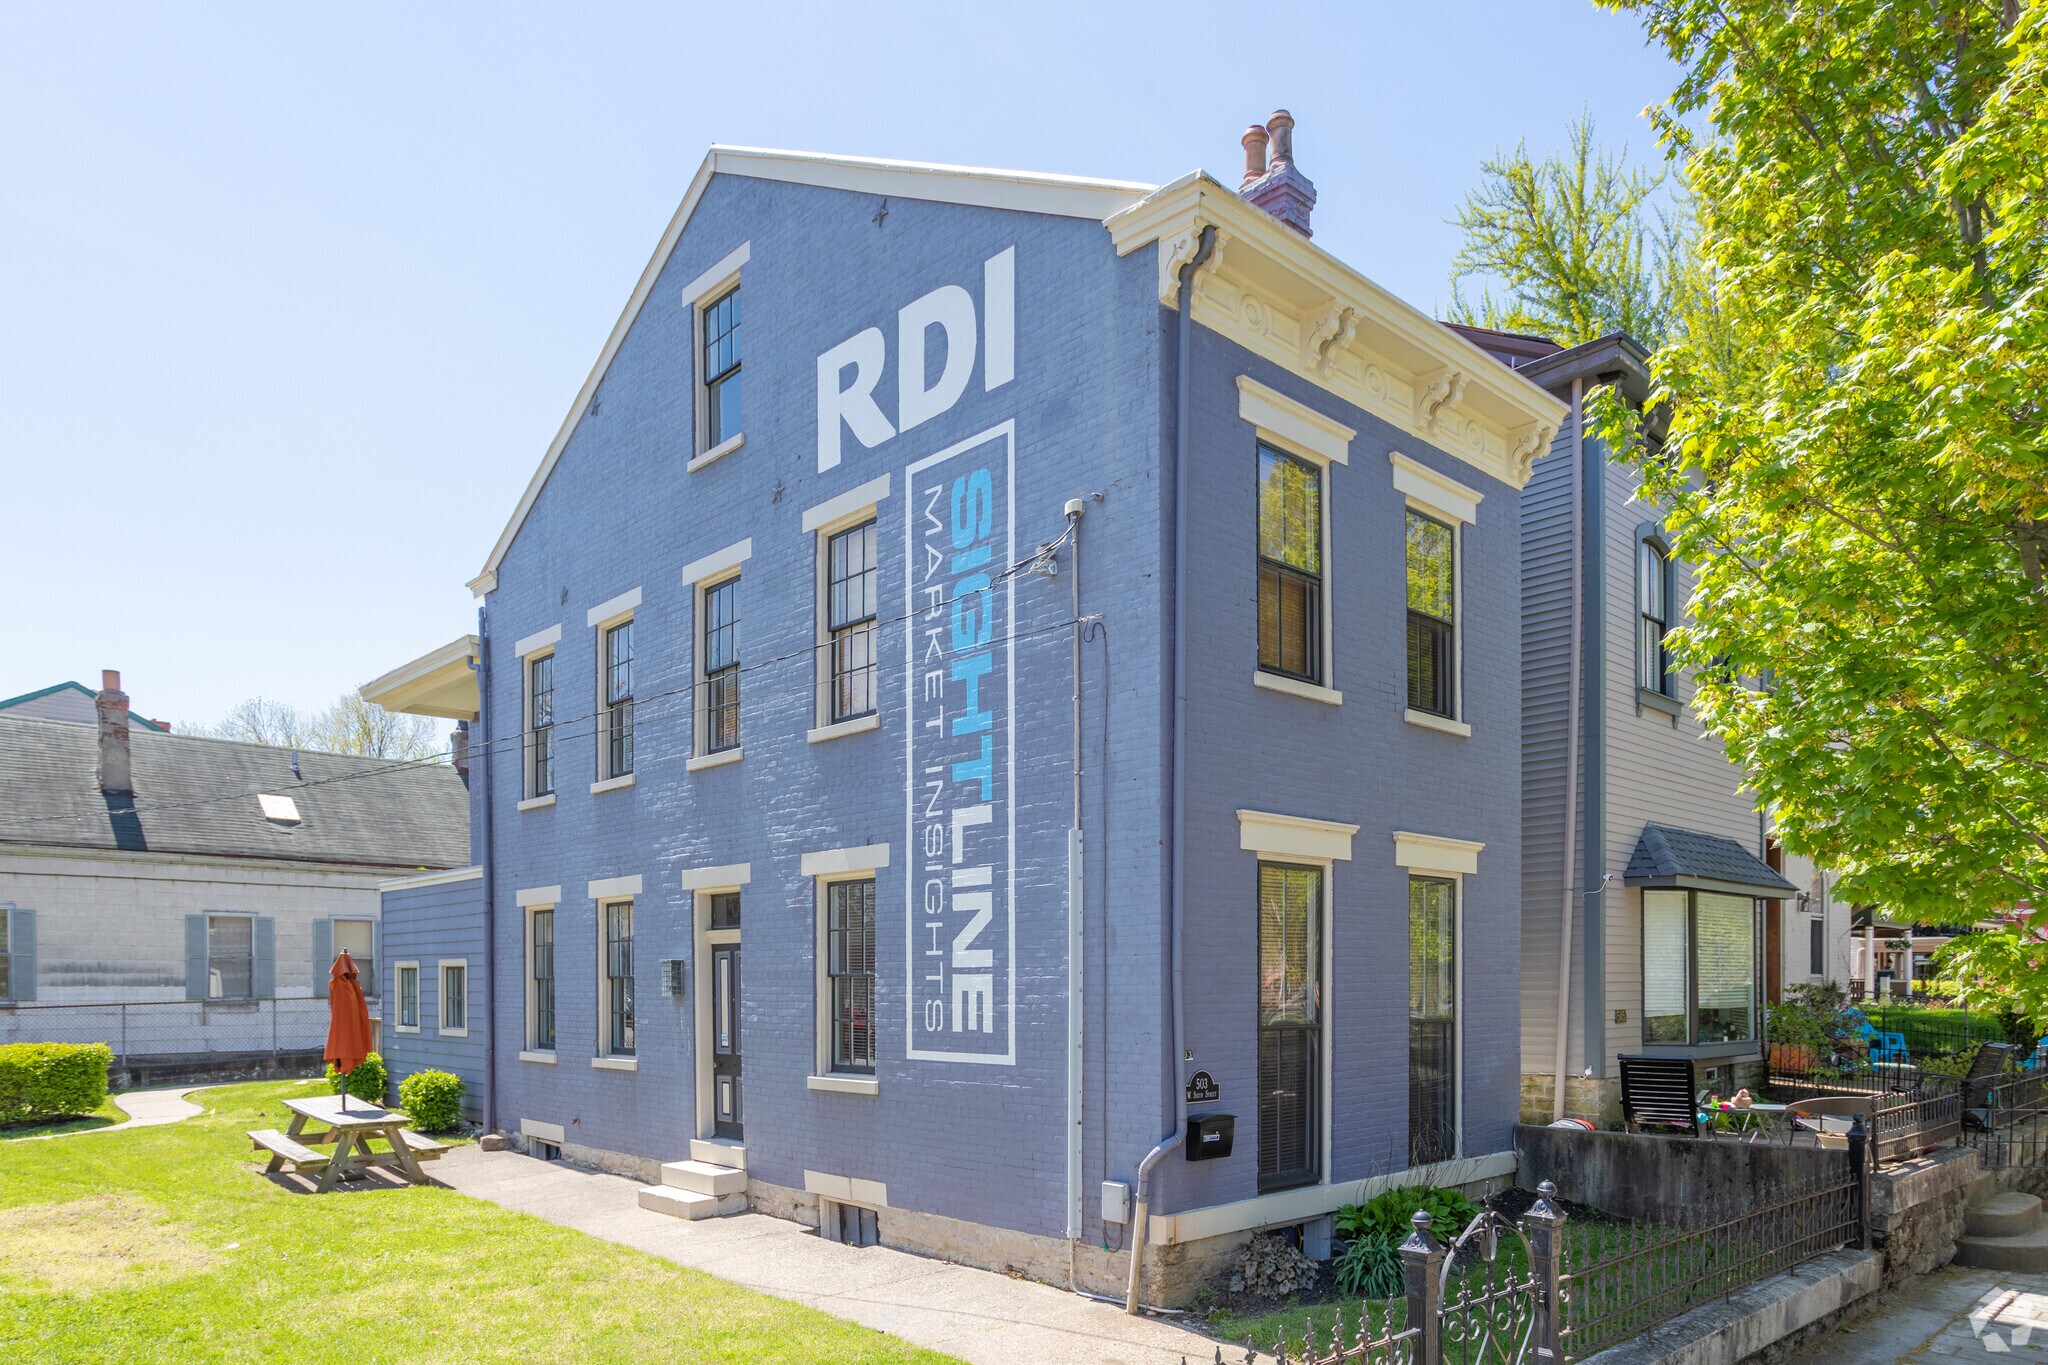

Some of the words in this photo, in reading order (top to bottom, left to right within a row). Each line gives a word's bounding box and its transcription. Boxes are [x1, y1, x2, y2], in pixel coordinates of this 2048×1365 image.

[817, 244, 1015, 474] RDI
[924, 484, 943, 738] MARKET
[924, 765, 943, 1032] INSIGHTS
[1195, 1077, 1208, 1090] 503
